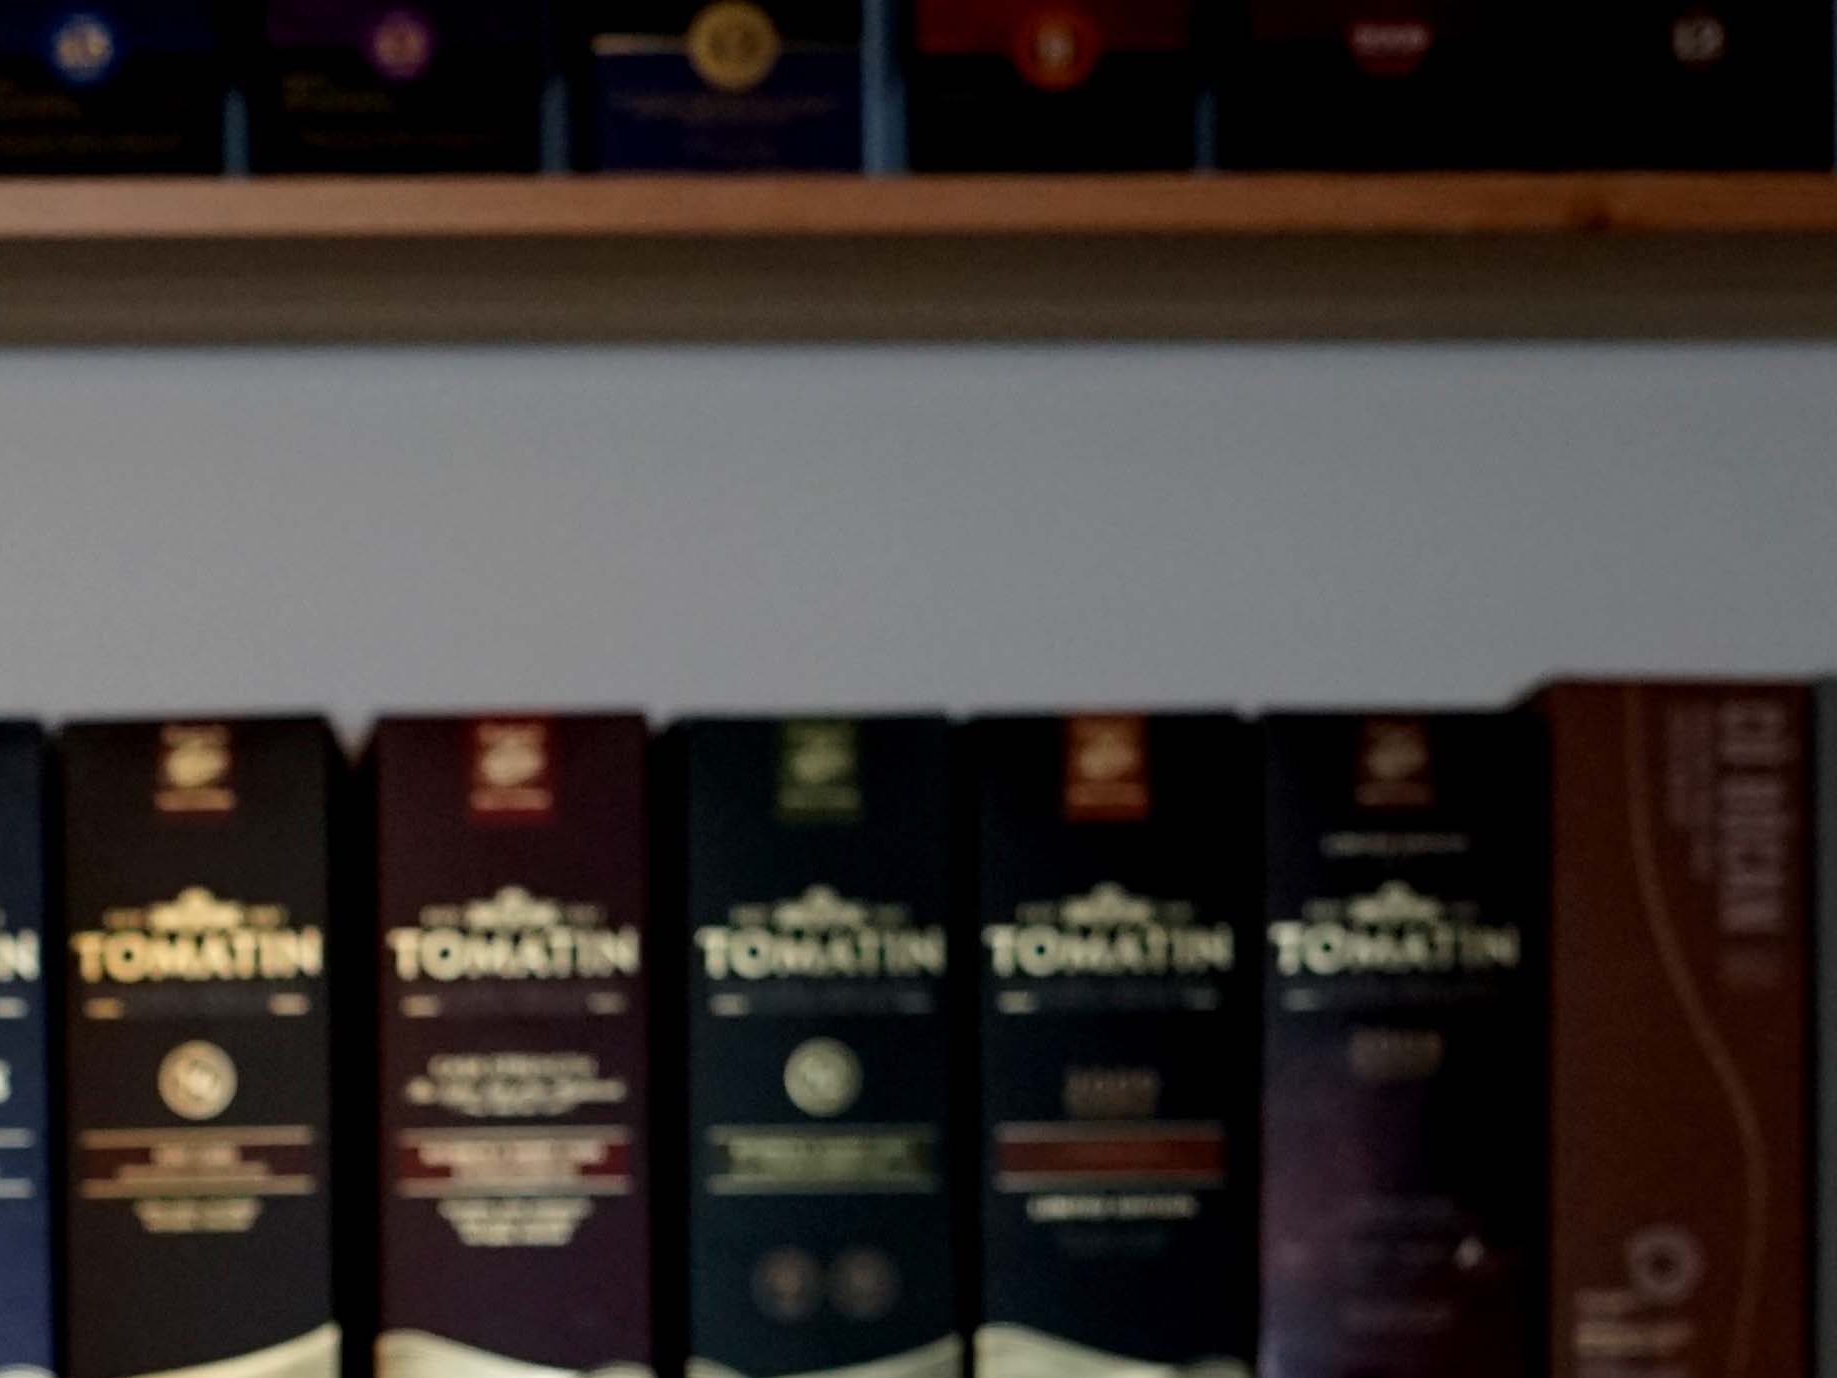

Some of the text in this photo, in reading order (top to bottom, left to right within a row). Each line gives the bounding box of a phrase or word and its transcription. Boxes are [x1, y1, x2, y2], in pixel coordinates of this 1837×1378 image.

[74, 927, 322, 981] TOMATIN
[387, 927, 639, 980] TOMATIN
[694, 924, 947, 980] TOMATIN
[982, 924, 1233, 978] TOMATIN
[1267, 921, 1519, 976] TOMATIN
